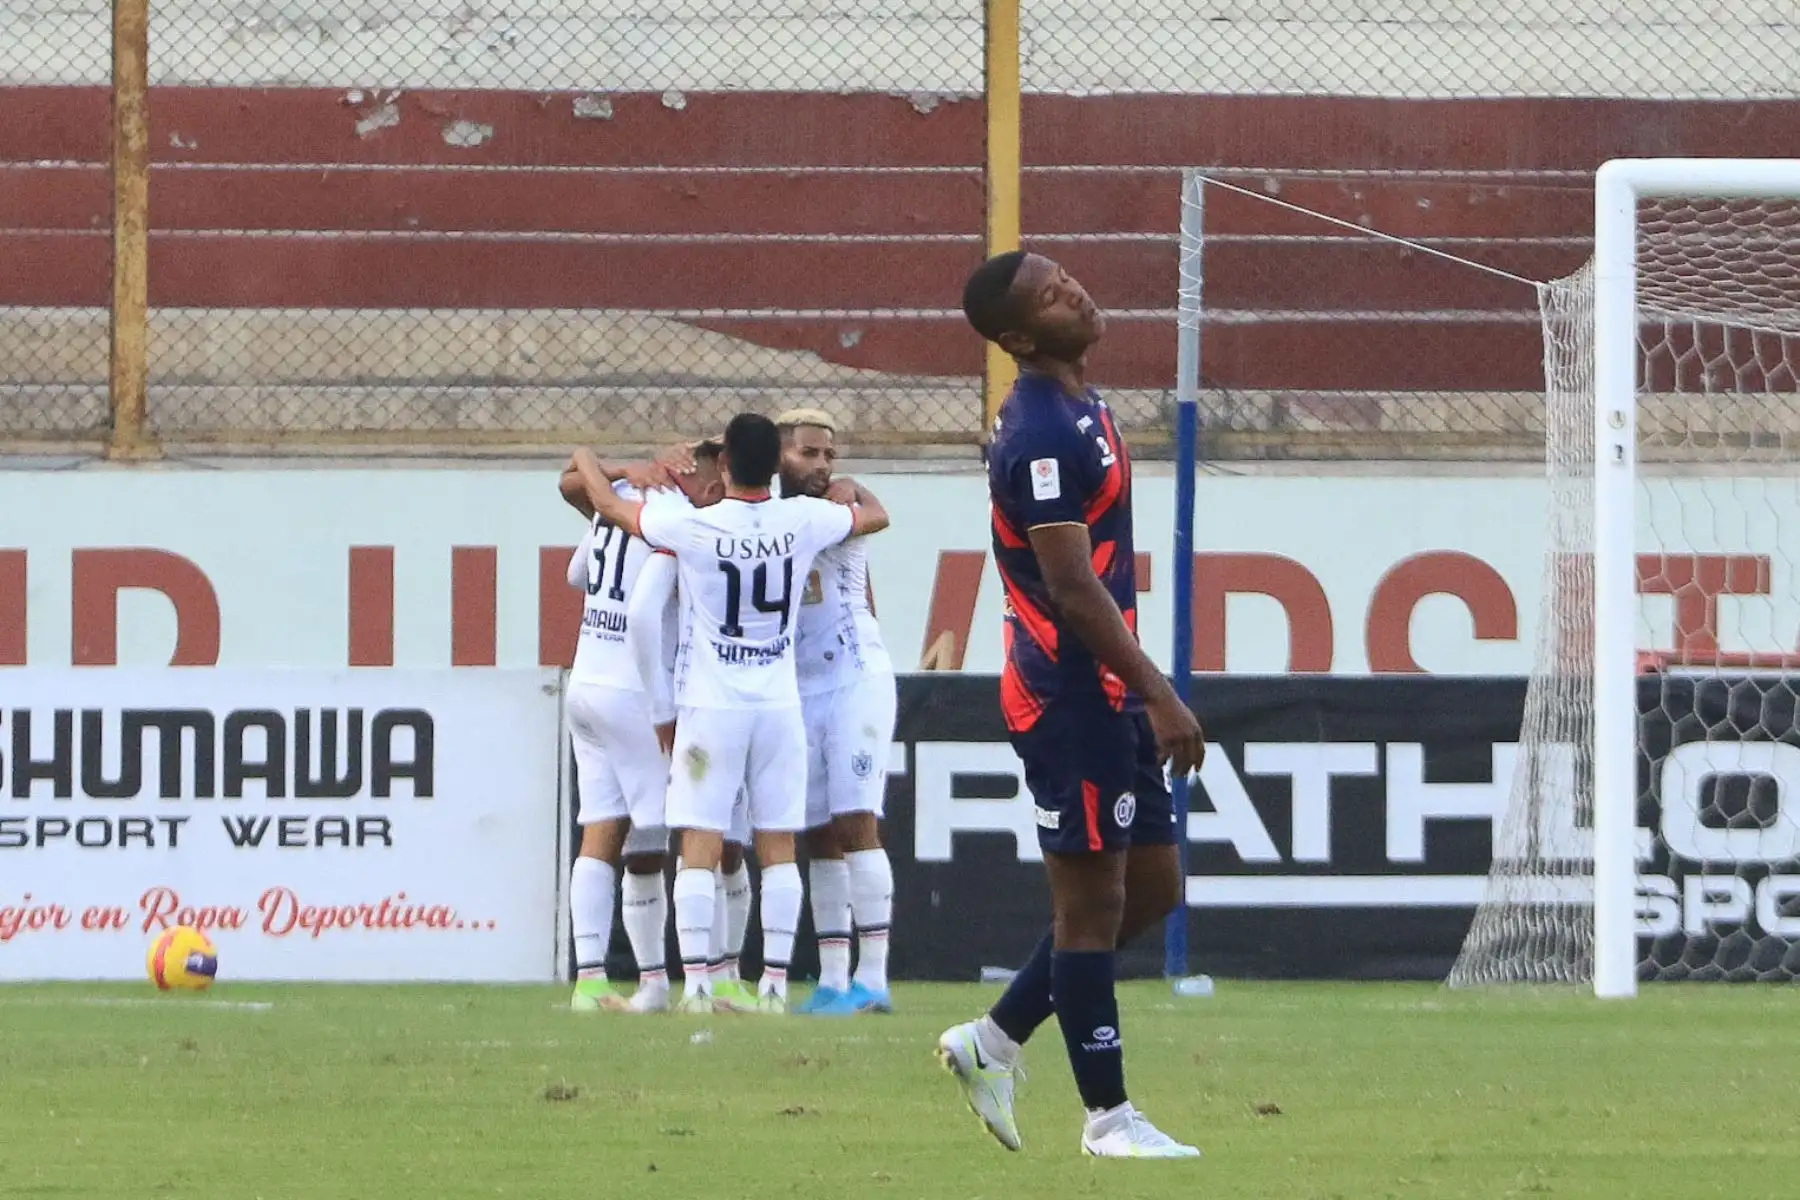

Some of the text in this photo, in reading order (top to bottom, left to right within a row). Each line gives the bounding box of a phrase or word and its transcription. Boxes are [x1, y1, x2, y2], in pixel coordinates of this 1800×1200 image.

[586, 516, 630, 602] 31
[716, 532, 795, 559] USMP
[718, 556, 793, 637] 14
[0, 708, 435, 798] HUMAWA
[0, 816, 393, 848] SPORT WEAR
[81, 905, 131, 930] en
[139, 886, 247, 934] Ropa
[257, 885, 497, 939] Deportiva...
